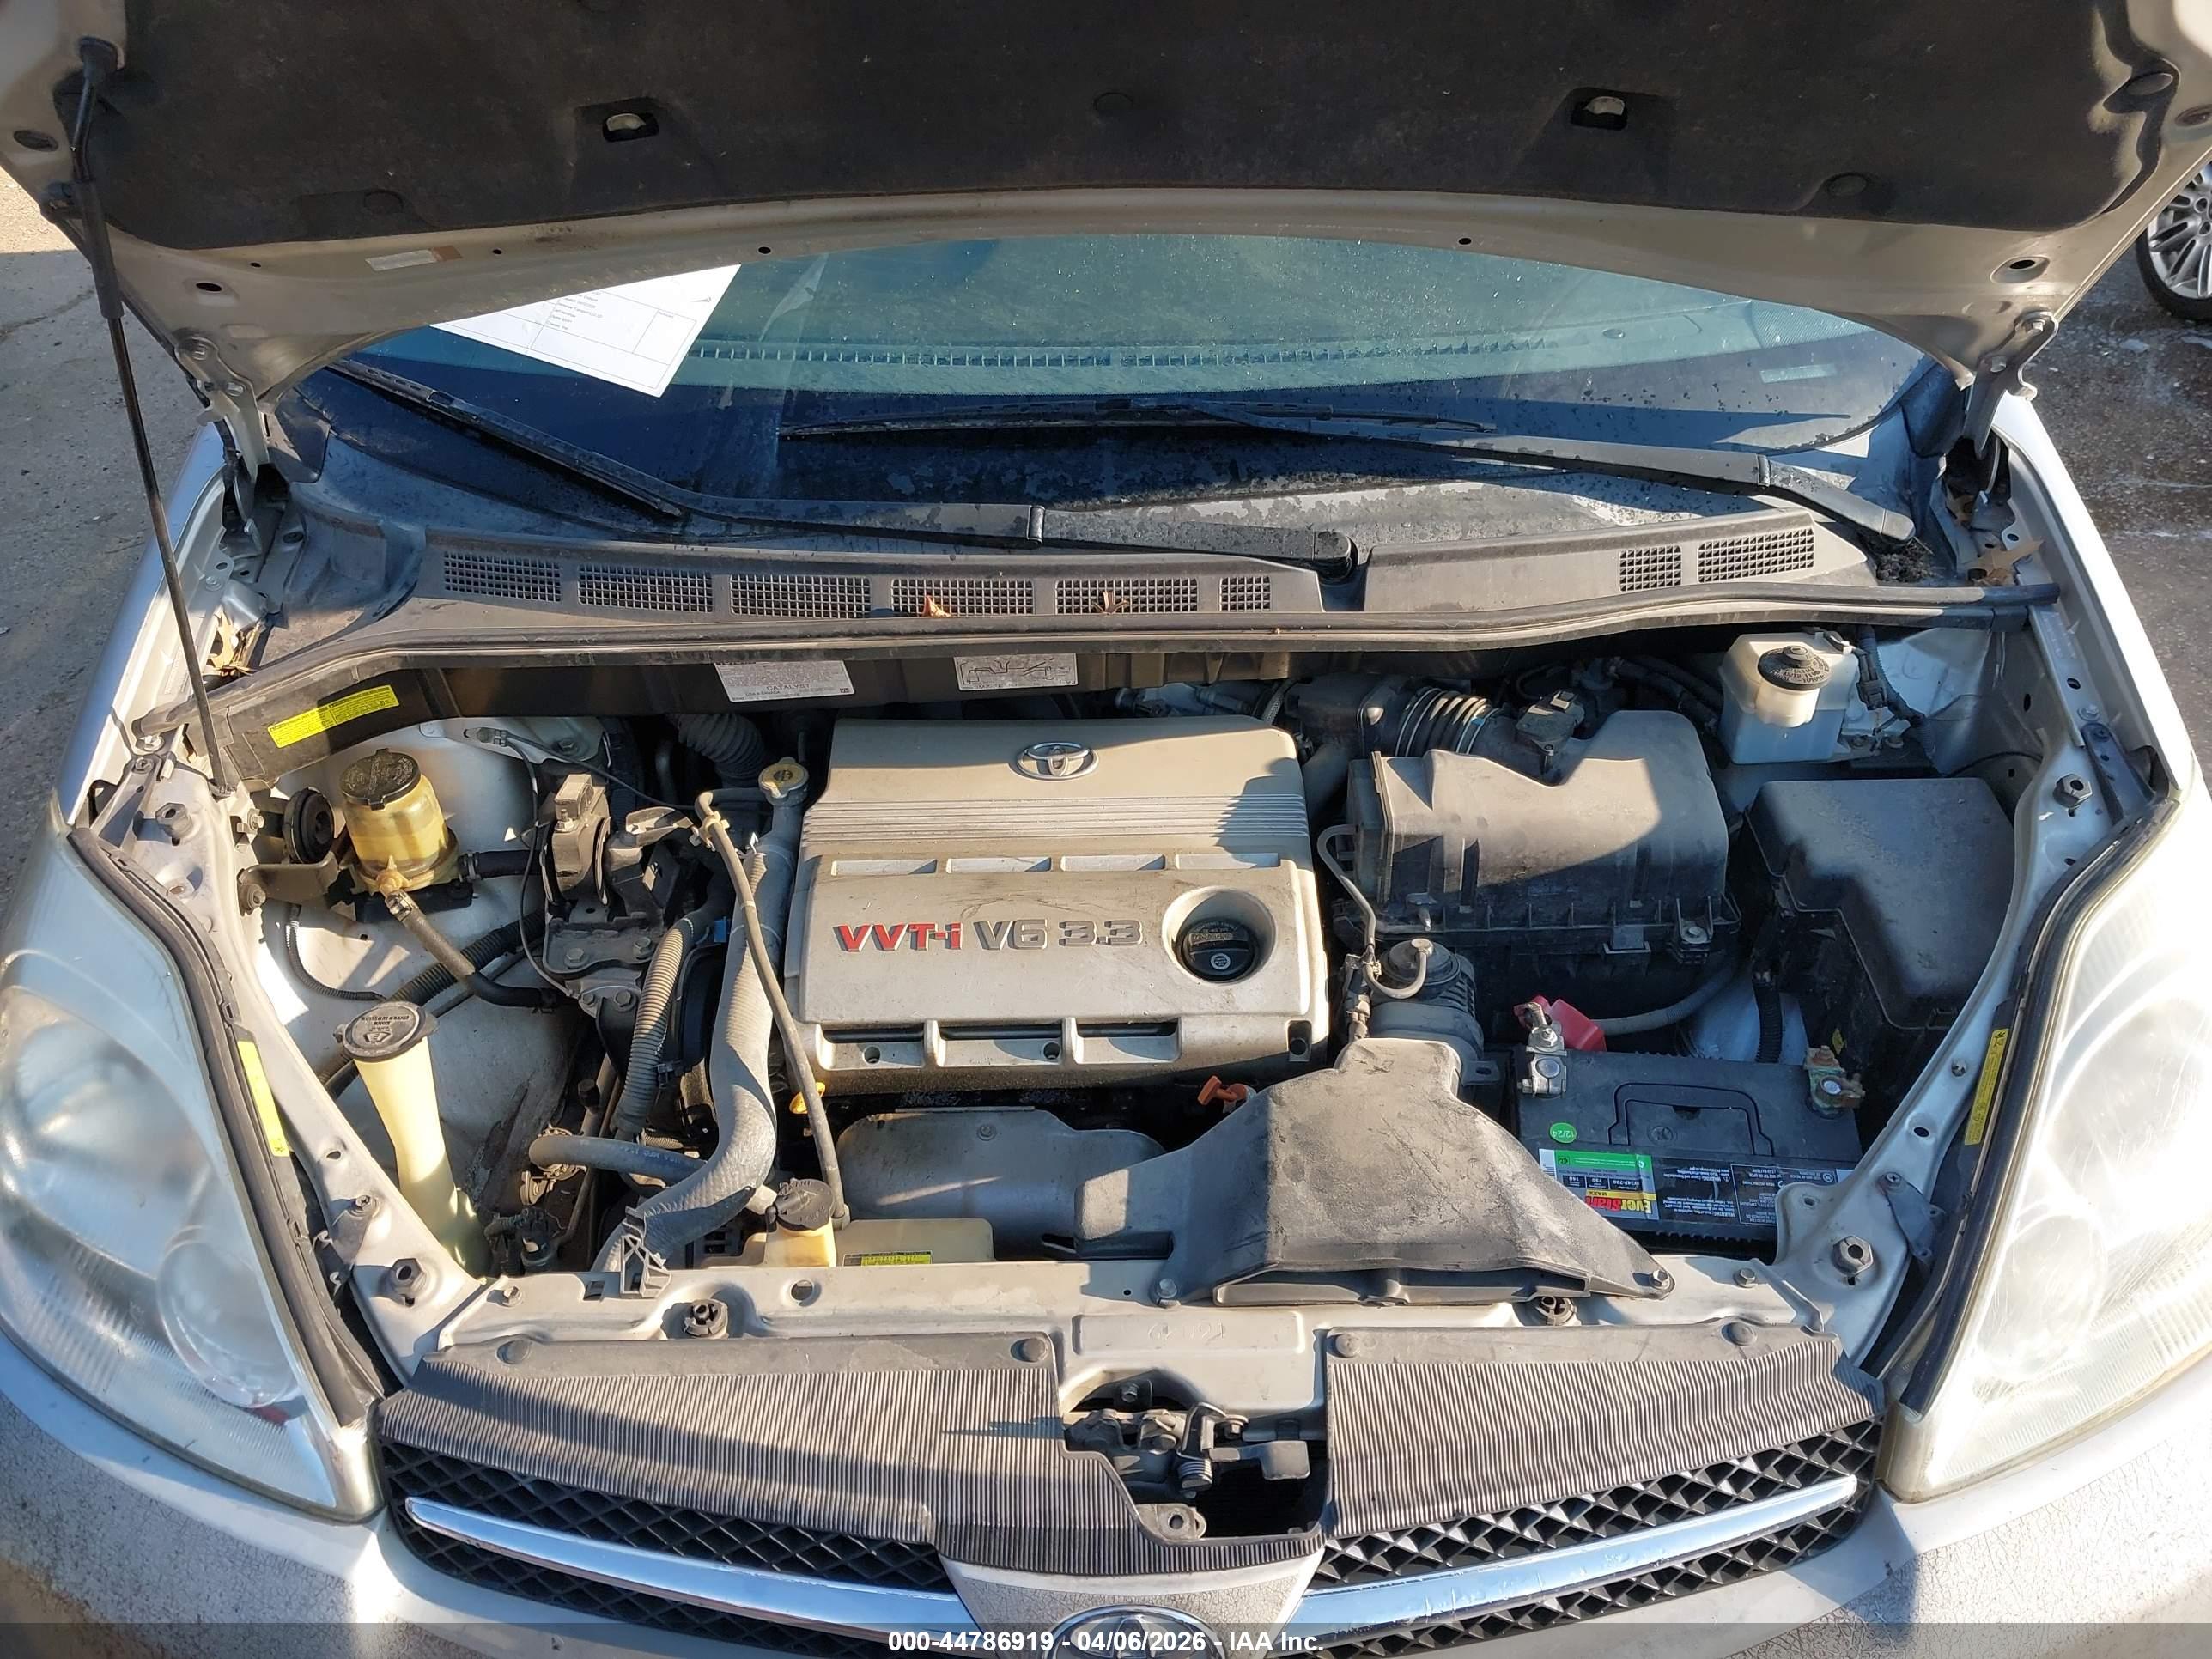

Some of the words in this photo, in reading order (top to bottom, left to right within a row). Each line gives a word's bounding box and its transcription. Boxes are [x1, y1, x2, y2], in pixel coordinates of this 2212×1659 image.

[833, 921, 963, 953] VVT-i
[973, 919, 1049, 950] V6
[1059, 919, 1144, 947] 3.3
[1552, 1129, 1575, 1139] 12/24
